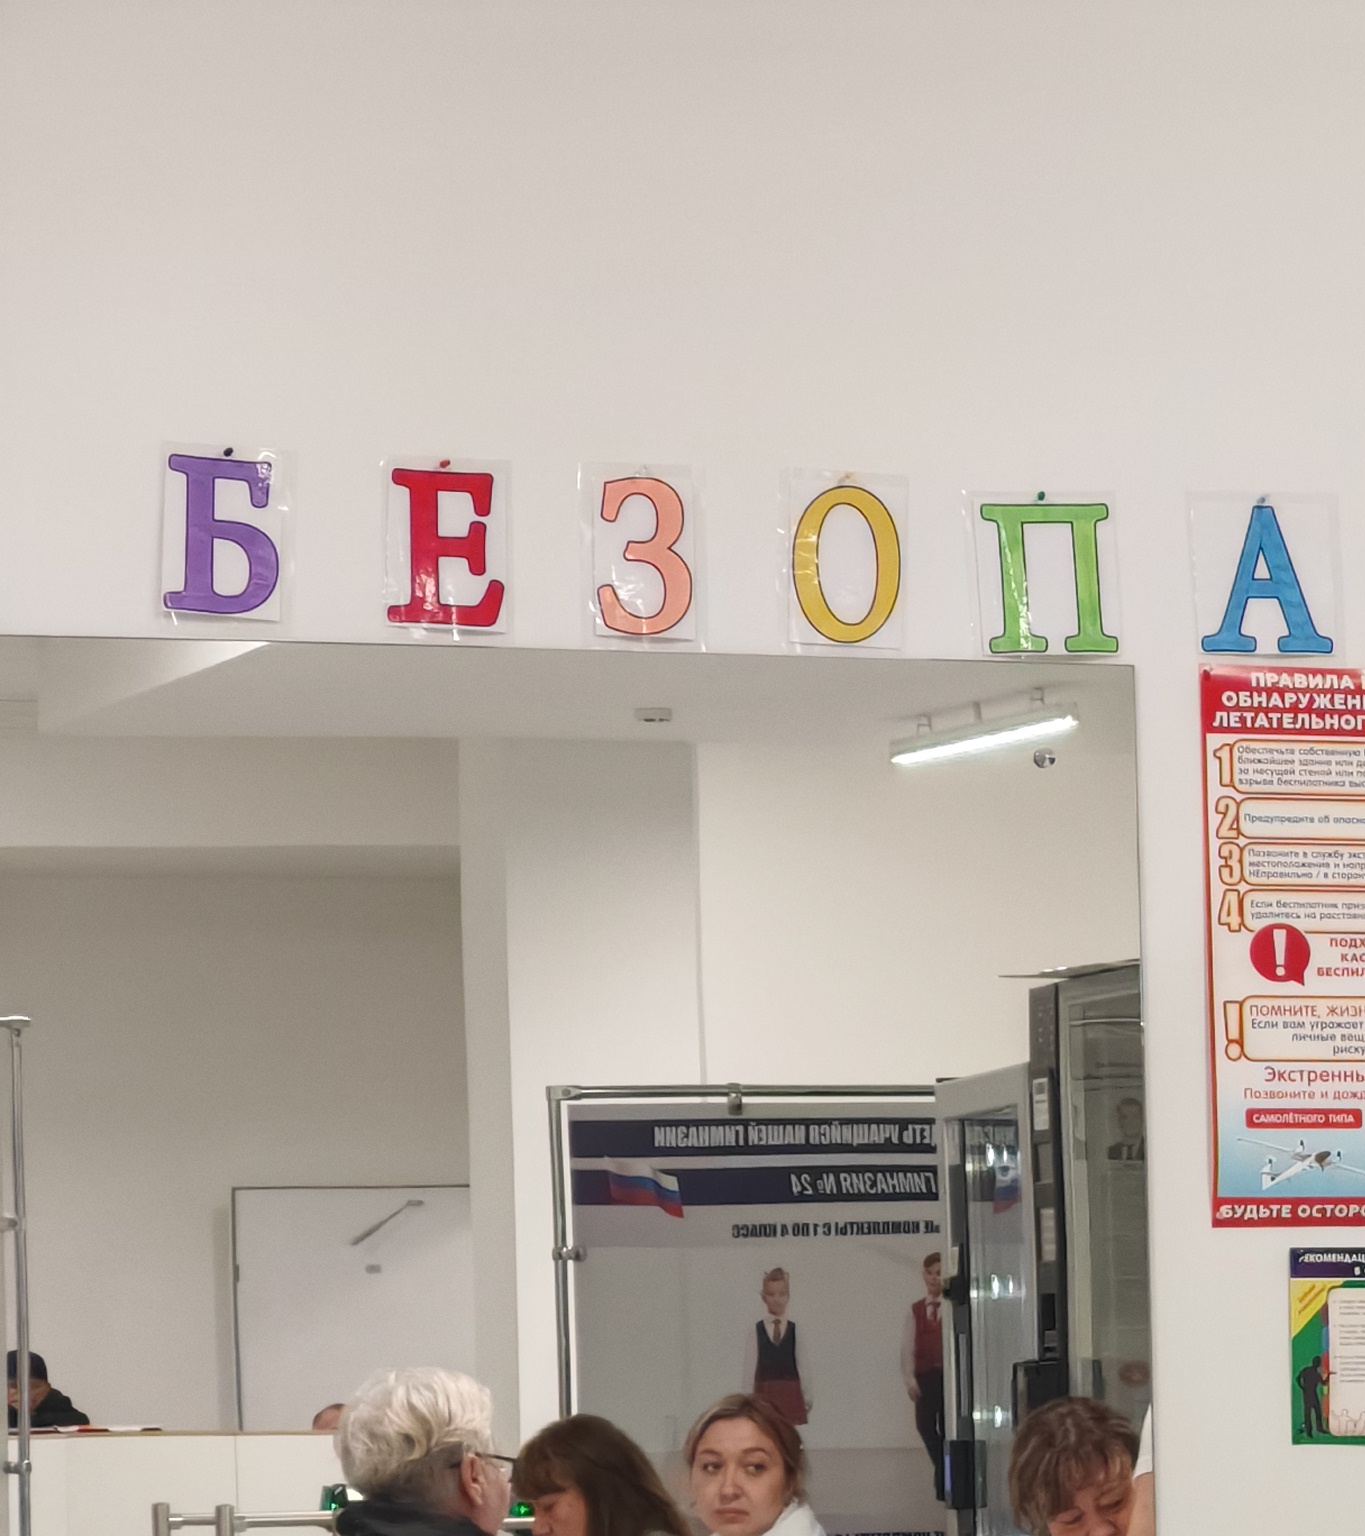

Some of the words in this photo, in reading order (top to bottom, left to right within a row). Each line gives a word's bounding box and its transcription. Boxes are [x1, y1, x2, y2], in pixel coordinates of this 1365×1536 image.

[1250, 671, 1352, 690] ПРАВИЛА
[1213, 743, 1233, 788] 1
[1215, 795, 1239, 840] 2
[1218, 841, 1243, 886] 3
[1218, 889, 1242, 932] 4
[1249, 1004, 1320, 1018] ПОМНИТЕ,
[1221, 1204, 1291, 1219] БУДЬТЕ
